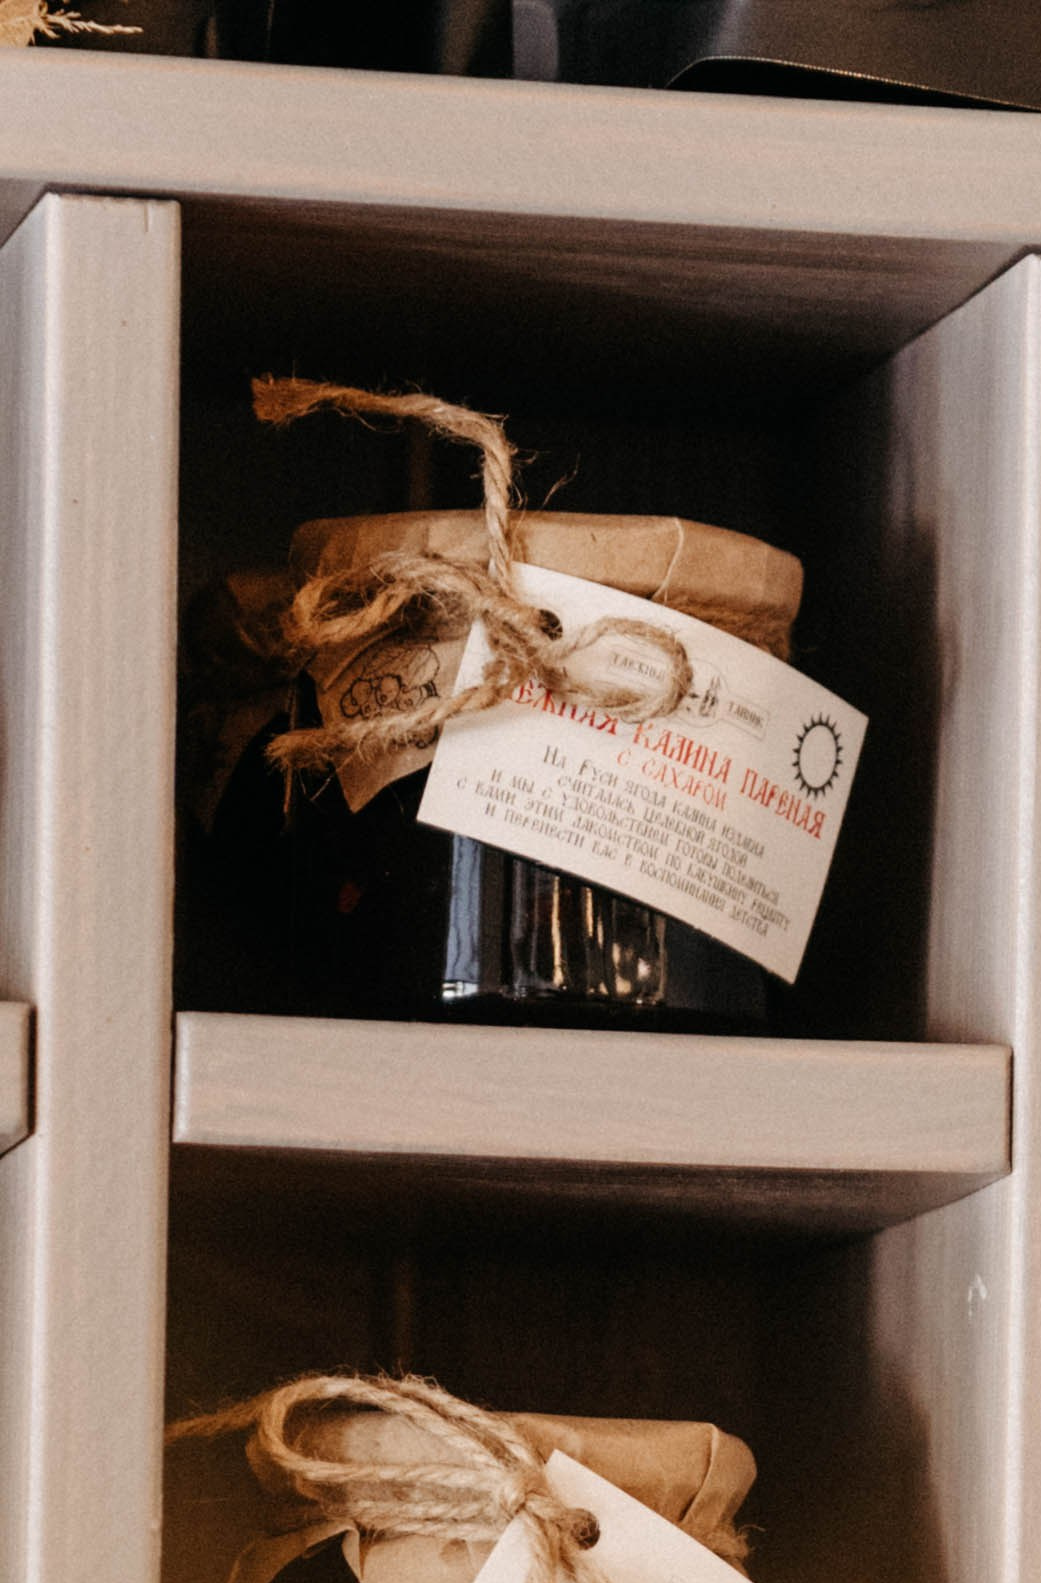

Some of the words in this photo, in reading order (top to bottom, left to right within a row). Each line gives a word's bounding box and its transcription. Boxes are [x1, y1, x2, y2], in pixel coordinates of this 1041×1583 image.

[510, 678, 624, 737] ЕЖНАЯ
[632, 718, 734, 783] КАЛИНА
[738, 768, 830, 839] ПАРЕНАЯ
[639, 755, 730, 812] САХАРОМ
